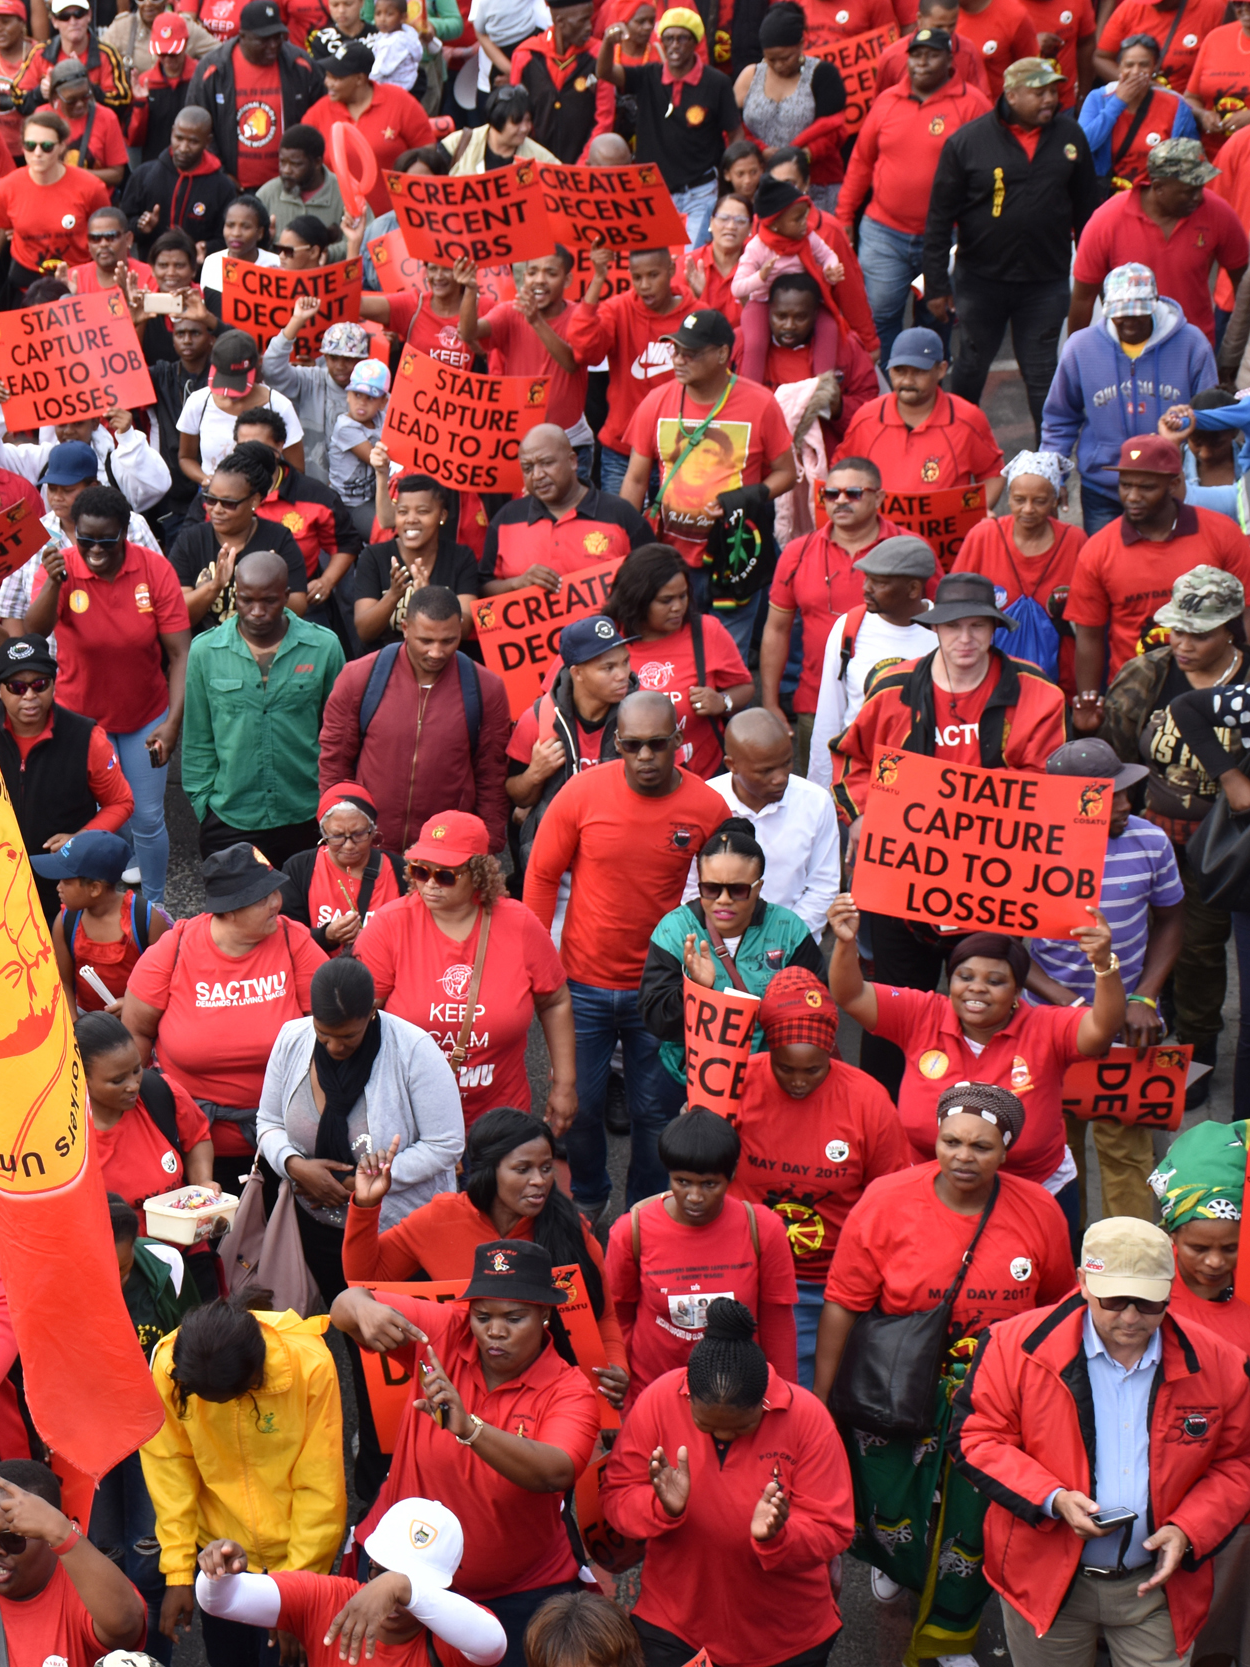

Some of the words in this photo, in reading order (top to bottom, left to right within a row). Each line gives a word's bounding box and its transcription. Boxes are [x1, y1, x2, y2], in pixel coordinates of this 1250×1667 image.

[204, 18, 234, 31] KEEP
[406, 175, 510, 205] CREATE
[540, 167, 636, 194] CREATE
[404, 200, 527, 234] DECENT
[545, 194, 656, 221] DECENT
[434, 235, 512, 261] JOBS
[572, 224, 648, 246] JOBS
[242, 271, 337, 298] CREATE
[21, 301, 86, 336] STATE
[234, 296, 348, 330] DECNT
[11, 326, 112, 367] CAPTURE
[430, 348, 470, 367] KEEP
[640, 342, 674, 364] NIK
[59, 362, 90, 387] TO
[100, 350, 142, 378] JOB
[435, 368, 502, 402] STATE
[34, 384, 118, 422] LOSSES
[414, 390, 519, 432] CAPTURE
[388, 408, 440, 445] LEAD
[448, 431, 481, 458] TO
[488, 439, 520, 461] JO
[414, 448, 498, 488] LOSSES
[502, 571, 613, 630] CREATE
[1150, 732, 1176, 764] IS
[870, 783, 900, 796] COSATU
[938, 768, 1039, 812] STATE
[903, 802, 1066, 856] CAPTURE
[1073, 818, 1108, 826] COSATU
[864, 832, 949, 876] LEAD
[962, 853, 1012, 888] TO
[1022, 864, 1096, 900] JOB
[906, 883, 1039, 931] LOSSES
[196, 970, 286, 1000] SACTWU
[196, 998, 232, 1008] DEMANDS
[239, 996, 264, 1006] LIVING
[748, 1155, 778, 1171] MAY
[781, 1162, 810, 1177] DAY
[815, 1167, 849, 1178] 2017
[487, 1248, 518, 1256] POPCRU
[690, 1284, 700, 1292] safe
[966, 1288, 998, 1300] DAY
[1002, 1286, 1030, 1300] 2017
[558, 1302, 588, 1314] OSATU
[759, 1452, 797, 1466] POPCRU
